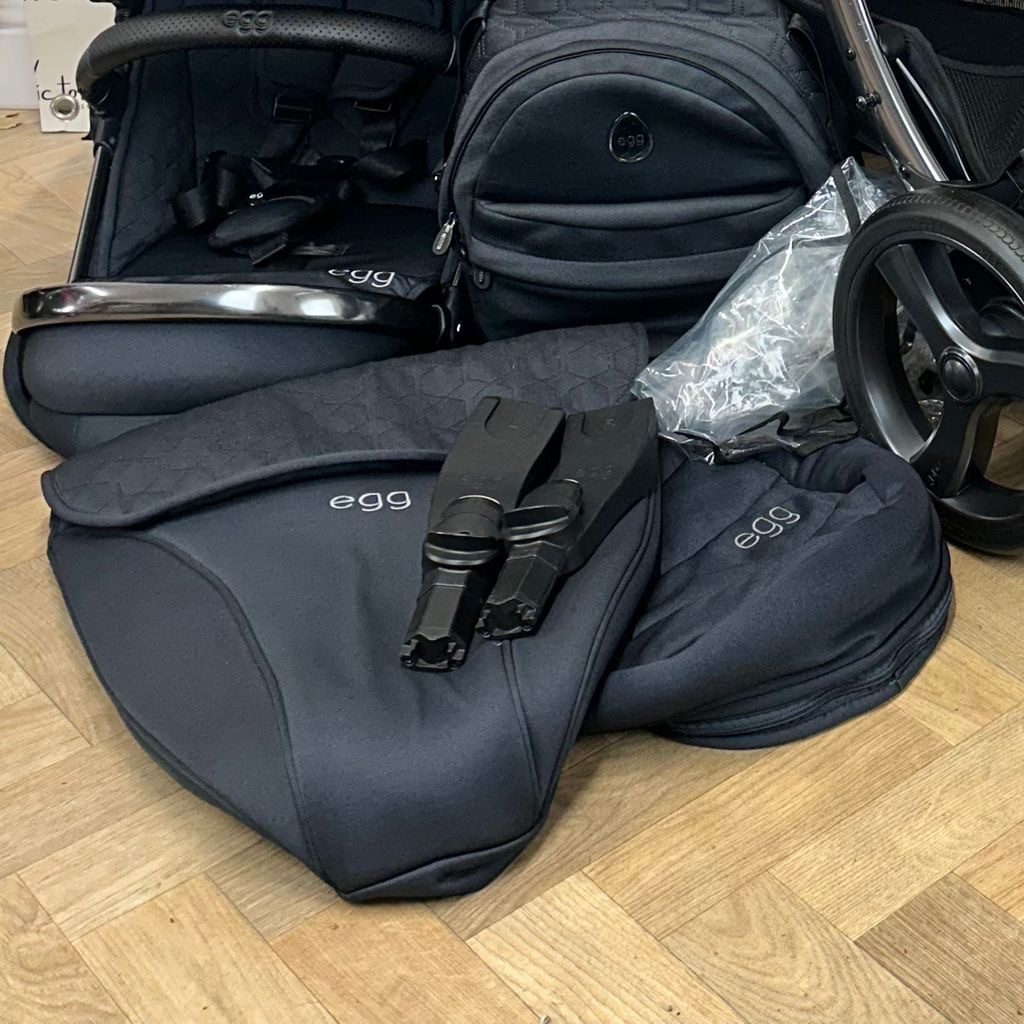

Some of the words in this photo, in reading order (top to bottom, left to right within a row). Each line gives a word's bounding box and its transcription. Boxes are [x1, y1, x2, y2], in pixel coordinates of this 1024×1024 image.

[222, 9, 275, 37] egg
[616, 133, 646, 149] egg
[327, 268, 397, 289] egg
[329, 490, 412, 512] egg
[734, 506, 801, 549] egg
